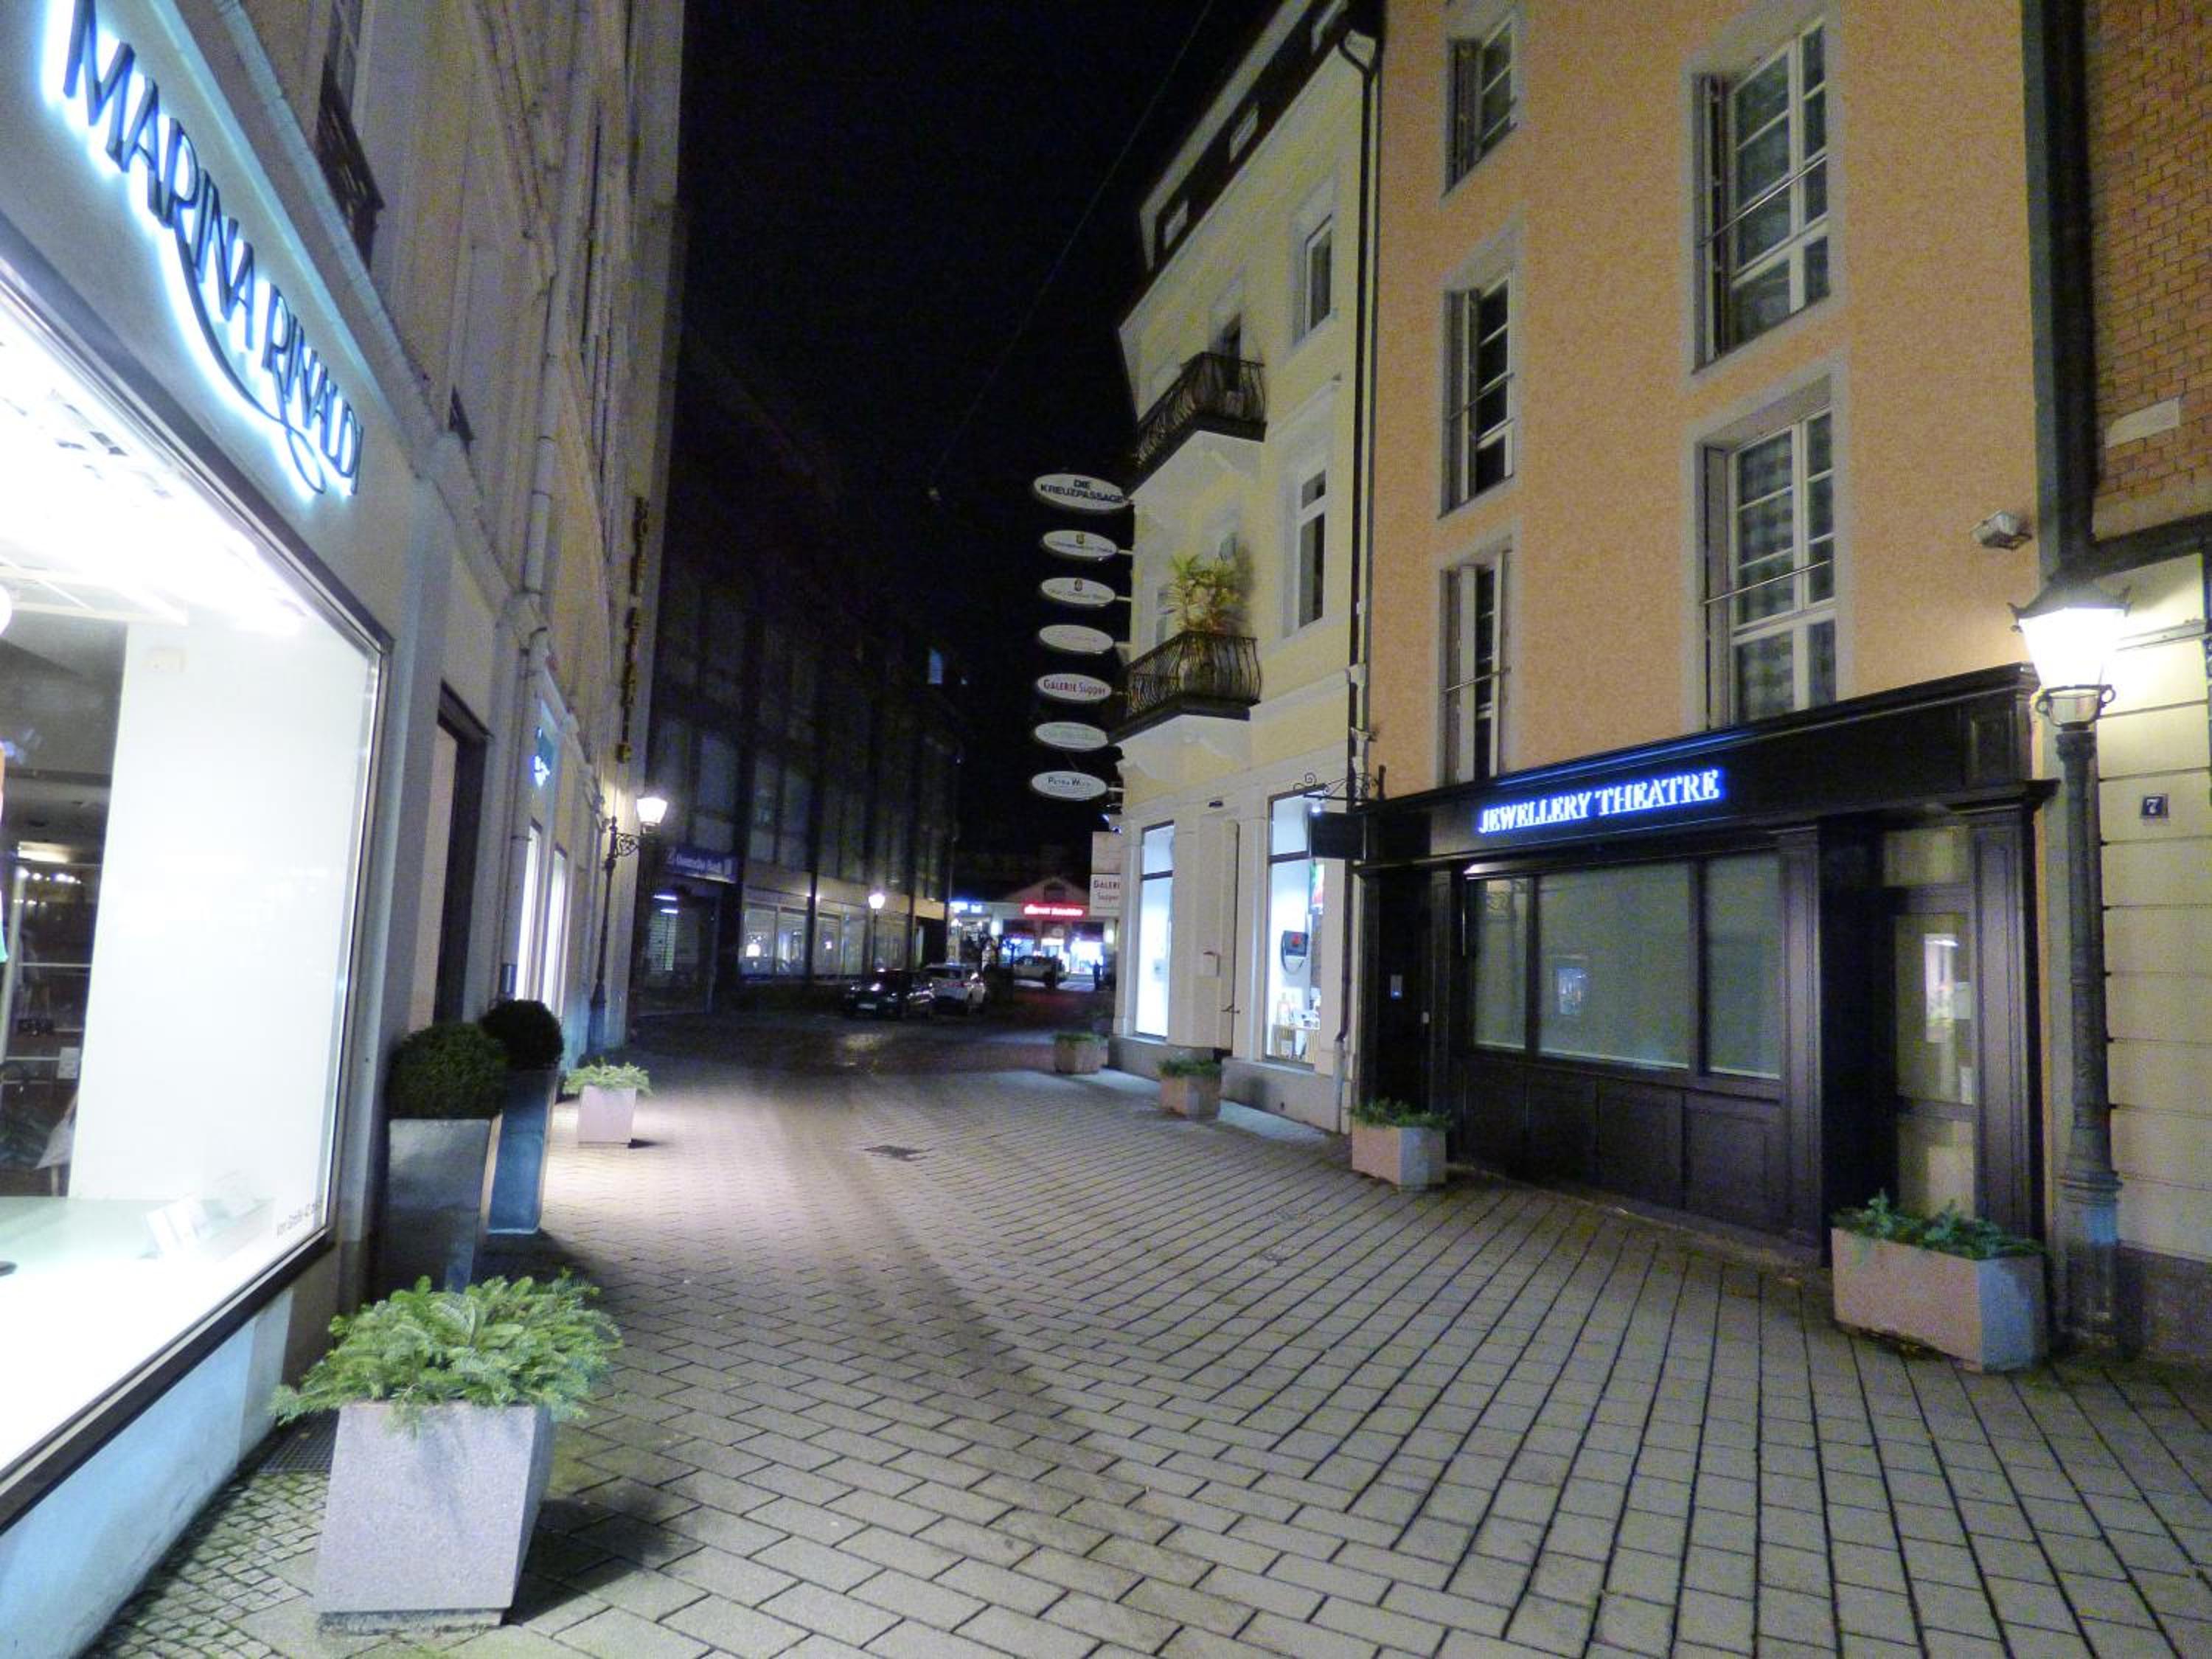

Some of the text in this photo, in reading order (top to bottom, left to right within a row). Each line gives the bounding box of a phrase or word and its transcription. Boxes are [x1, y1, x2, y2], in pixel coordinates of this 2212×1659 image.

[63, 0, 364, 495] MARINA RINALDI
[1478, 768, 1720, 834] JEWELLERY THEATRE
[2146, 799, 2158, 814] 7
[1093, 880, 1121, 889] GALERI
